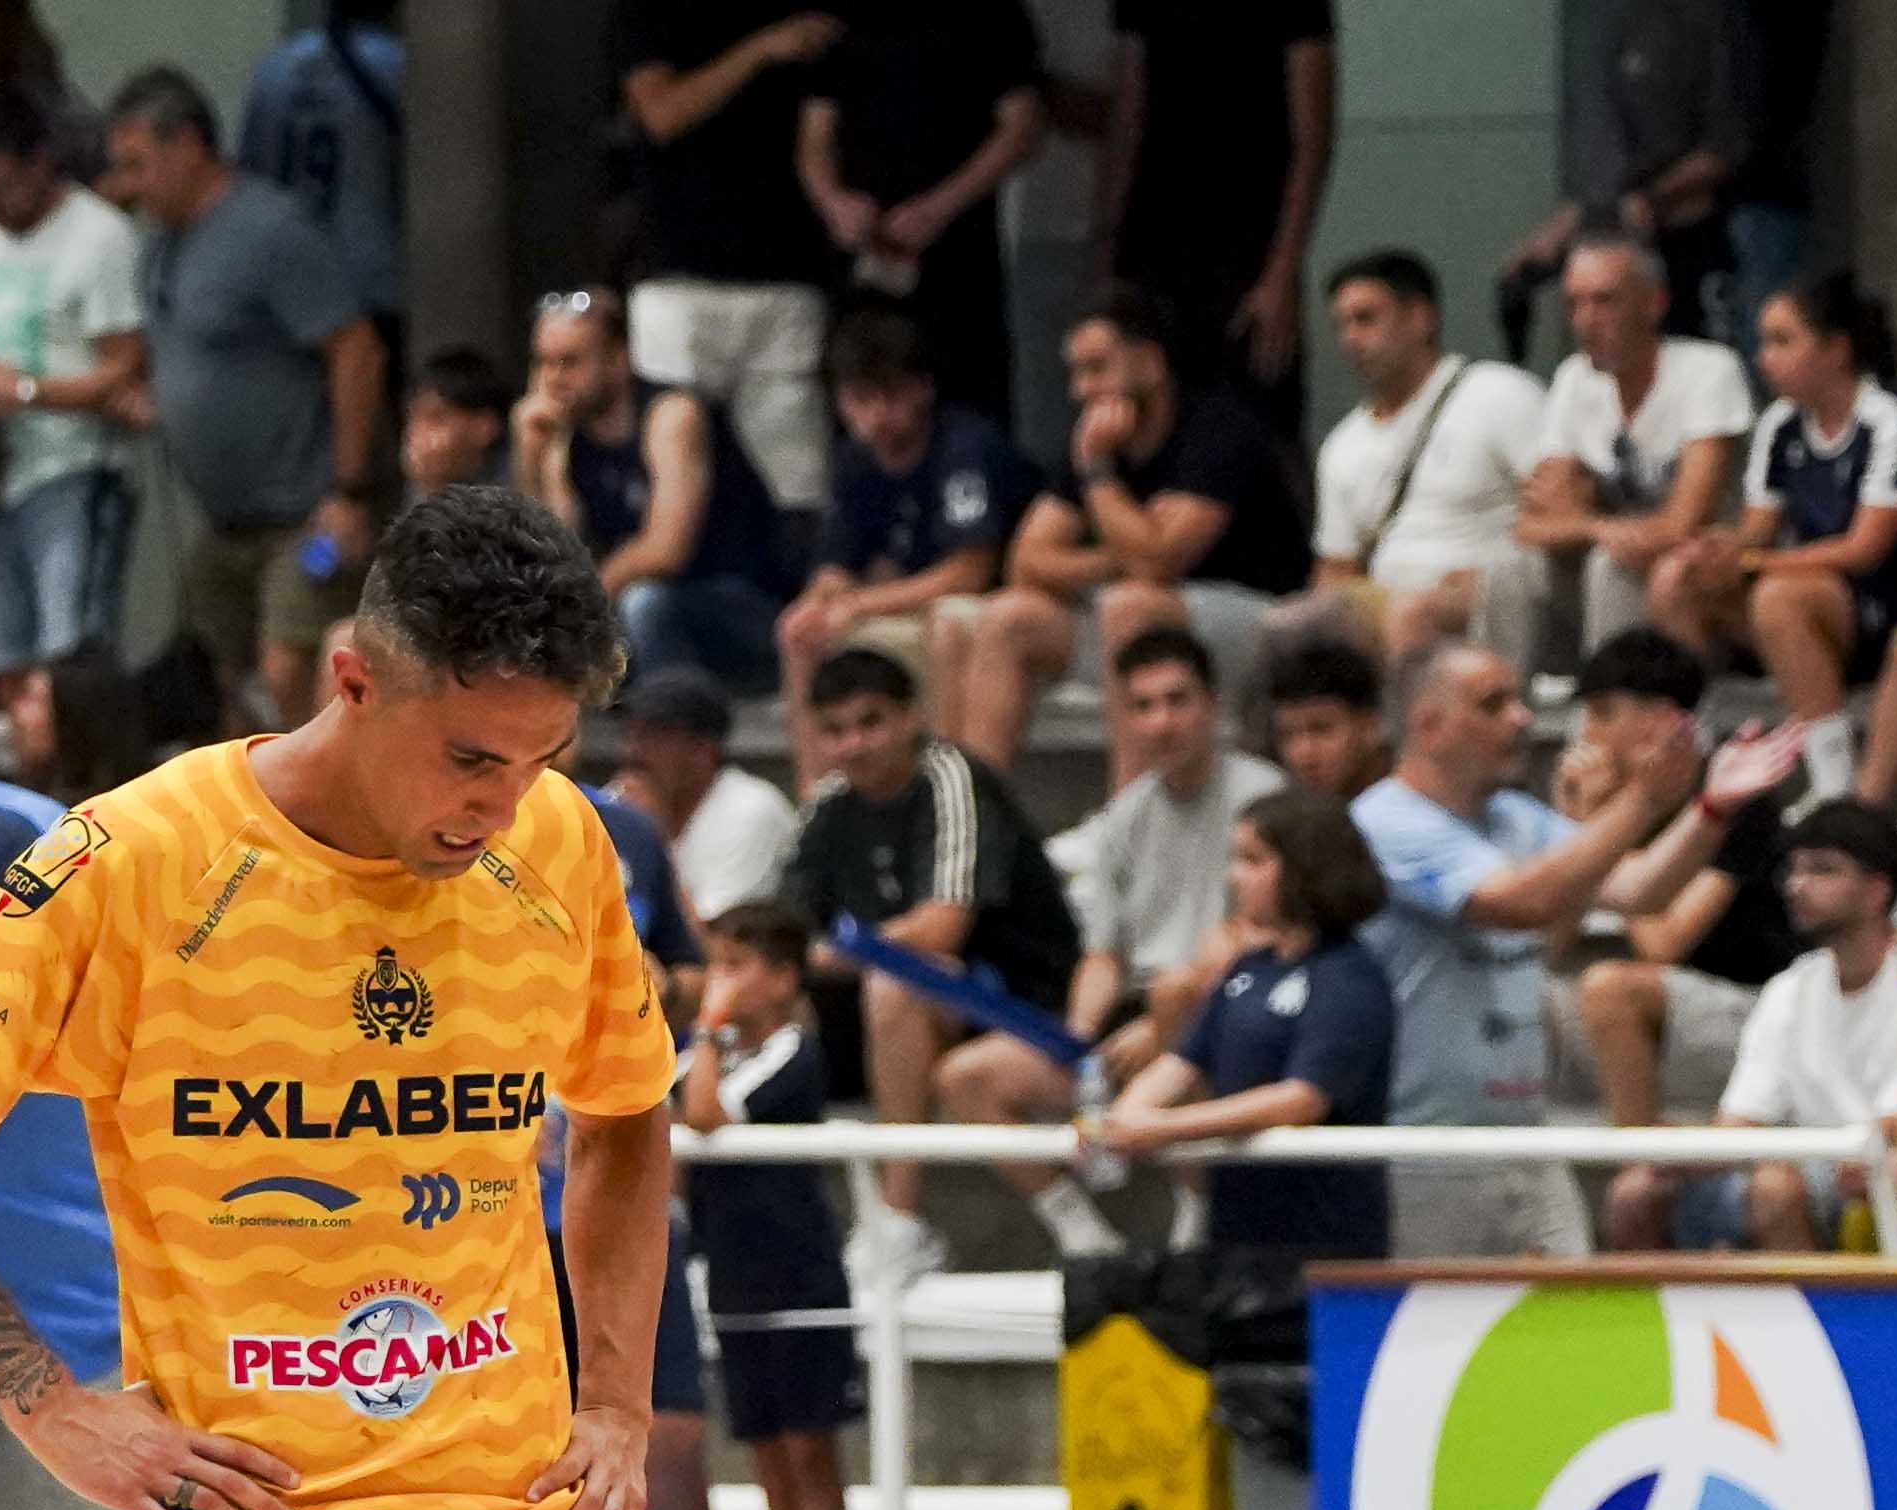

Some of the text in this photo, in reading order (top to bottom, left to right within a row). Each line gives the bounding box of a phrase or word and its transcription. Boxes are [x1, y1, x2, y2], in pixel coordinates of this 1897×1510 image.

[4, 868, 40, 897] RFGF
[172, 1071, 546, 1139] EXLABESA
[470, 1198, 508, 1213] Pon
[338, 1278, 444, 1311] CONSERVAS
